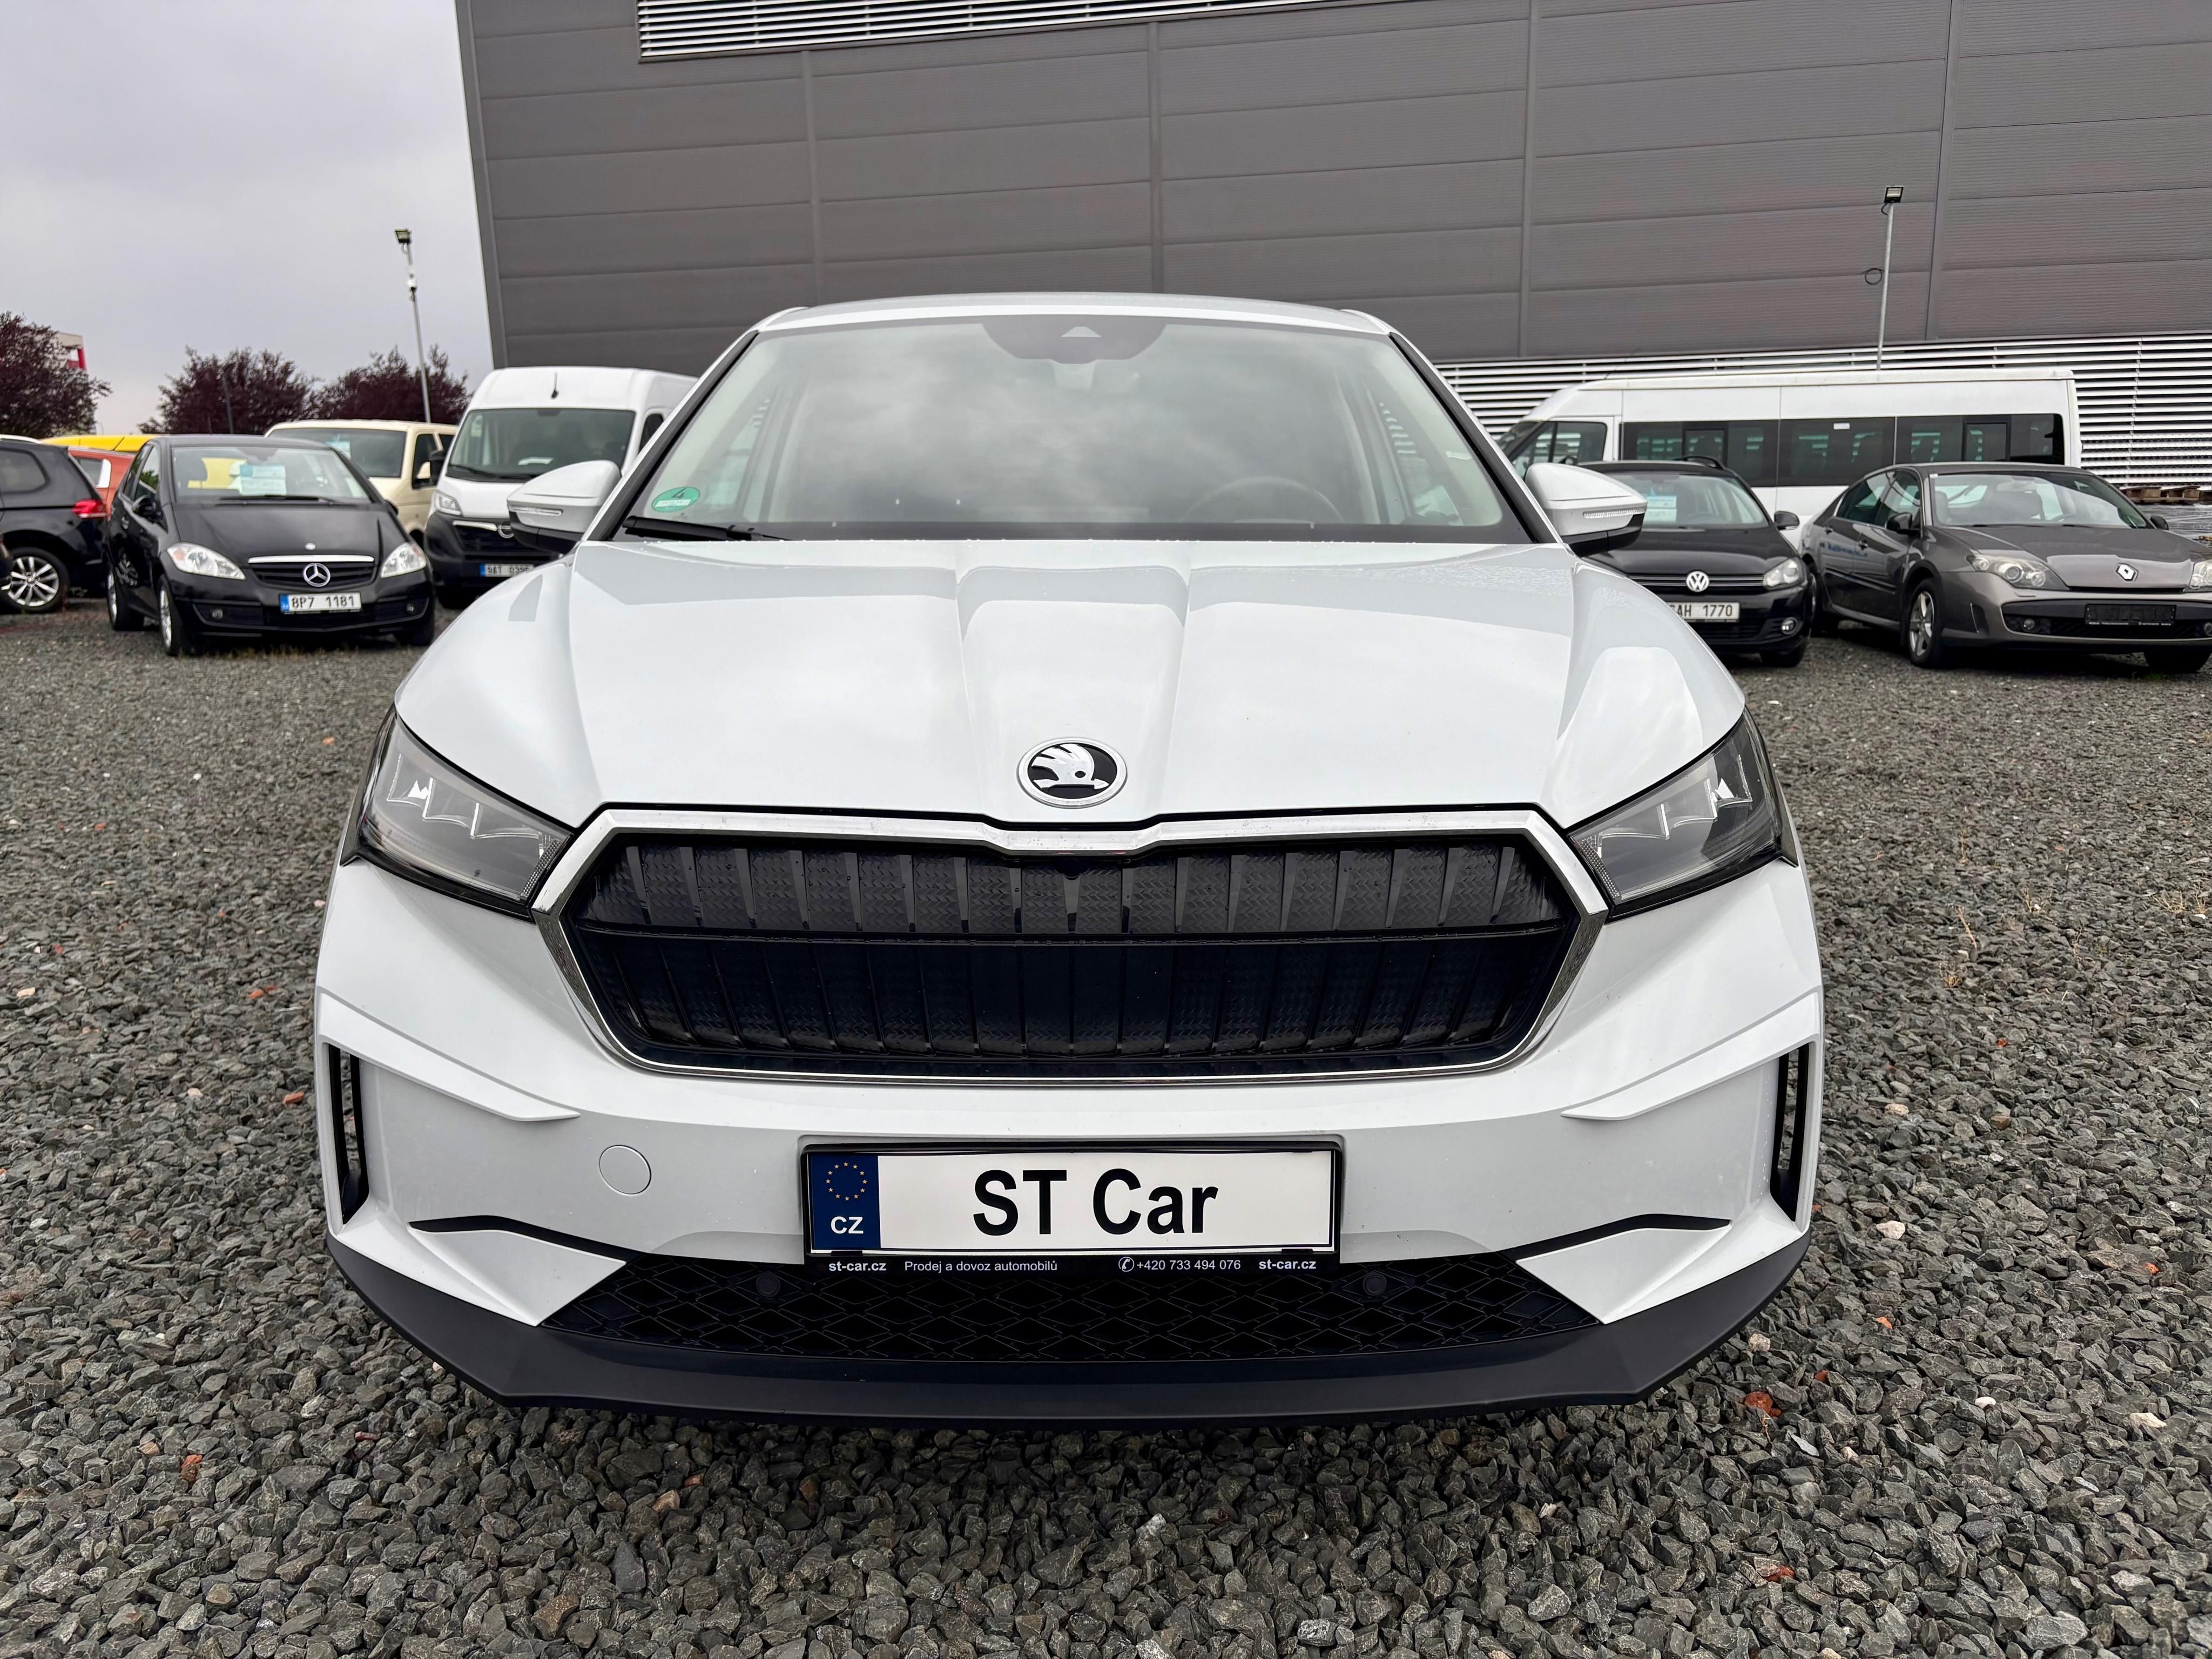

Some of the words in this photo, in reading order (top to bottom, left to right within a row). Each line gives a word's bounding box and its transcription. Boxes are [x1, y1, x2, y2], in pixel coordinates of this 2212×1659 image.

[671, 488, 686, 499] 4
[292, 597, 314, 608] 8P7
[326, 596, 355, 607] 1181
[1703, 604, 1732, 617] 1770
[974, 1170, 1067, 1236] ST
[1094, 1169, 1218, 1235] Car
[831, 1216, 864, 1234] CZ
[828, 1261, 886, 1271] st-car.cz
[905, 1261, 941, 1273] Prodej
[946, 1263, 953, 1271] a
[956, 1261, 990, 1271] dovoz
[994, 1260, 1057, 1271] automobilů
[1136, 1260, 1165, 1270] +420
[1169, 1260, 1191, 1270] 733
[1194, 1259, 1215, 1270] 494
[1219, 1259, 1241, 1270] 076
[1259, 1259, 1316, 1270] st-car.cz
